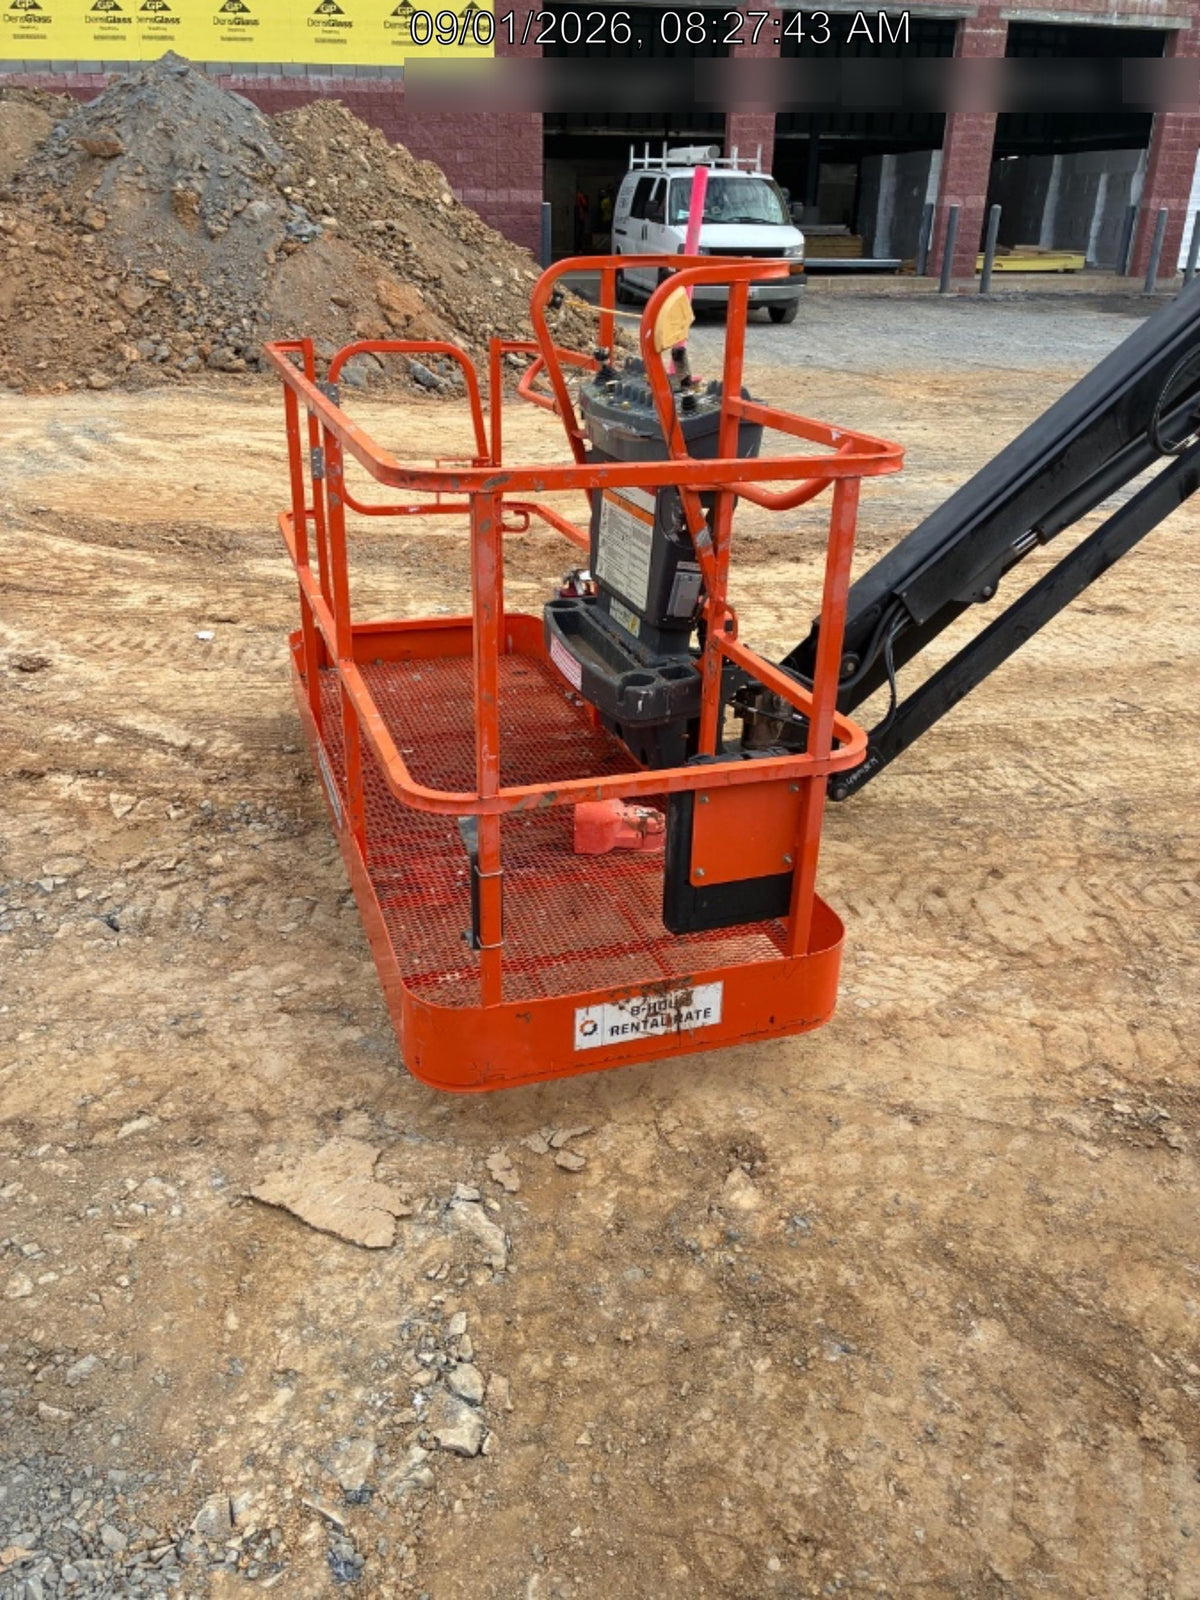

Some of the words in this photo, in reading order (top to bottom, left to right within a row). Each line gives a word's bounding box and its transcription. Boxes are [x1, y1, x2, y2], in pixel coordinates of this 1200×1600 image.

[85, 15, 132, 24] DensGlass
[610, 1014, 667, 1036] RENTAL
[673, 1007, 712, 1023] RATE
